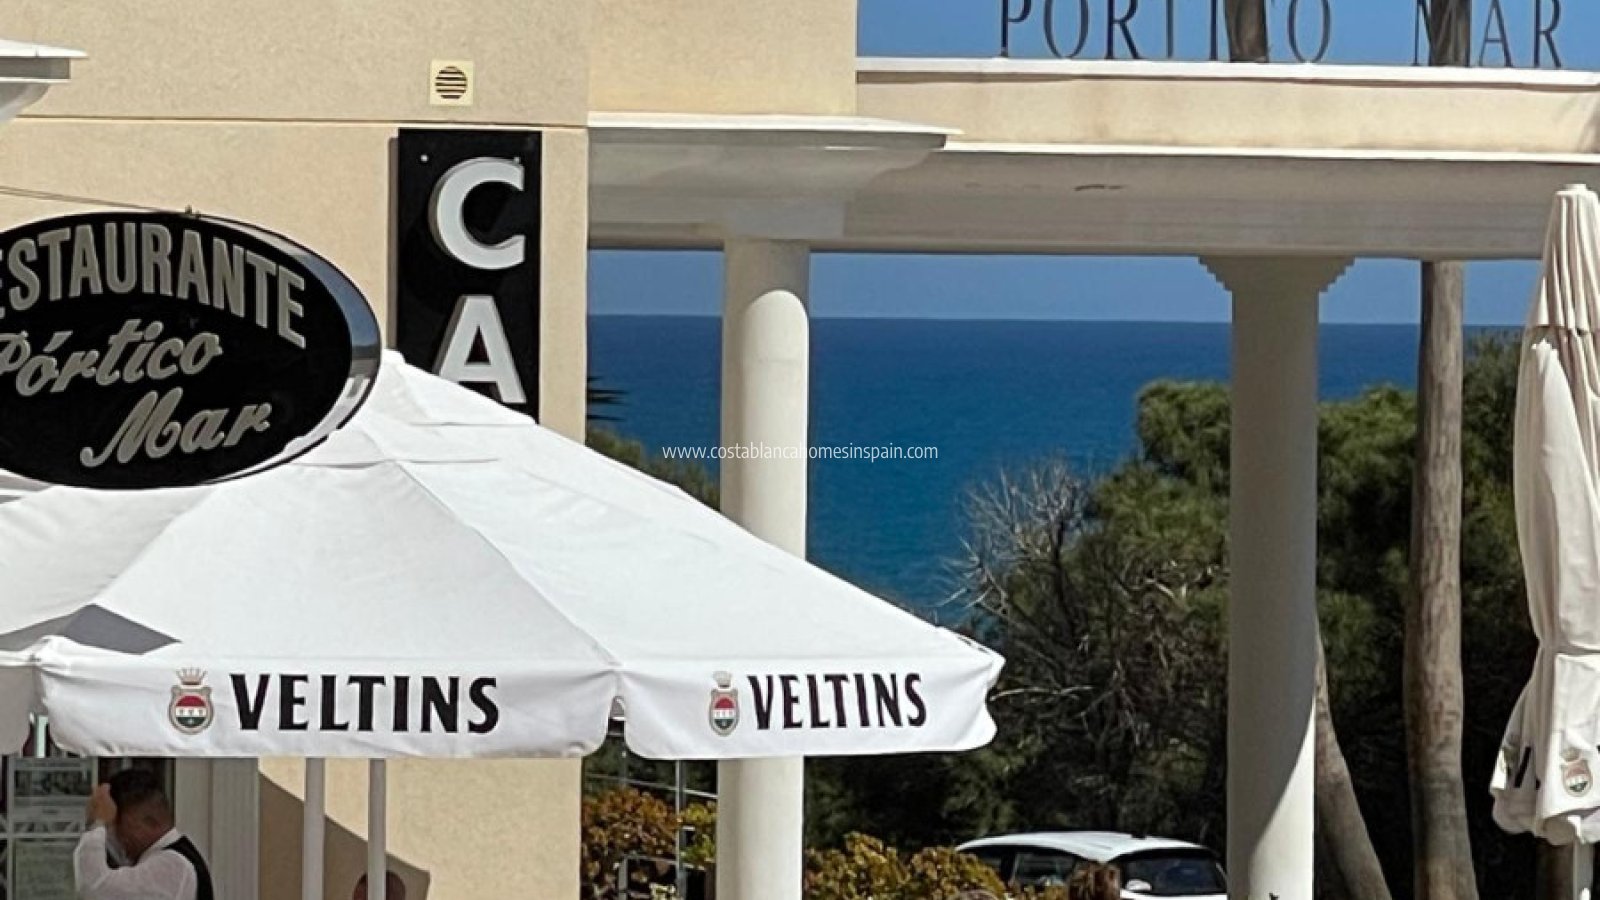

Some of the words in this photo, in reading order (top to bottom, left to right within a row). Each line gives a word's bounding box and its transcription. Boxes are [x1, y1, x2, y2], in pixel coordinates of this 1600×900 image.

[1000, 0, 1331, 63] PORTIO
[0, 222, 307, 349] STAURANTE
[429, 156, 527, 404] CA
[0, 318, 224, 397] Pórtico
[80, 387, 272, 468] Mar
[229, 673, 500, 733] VELTINS
[746, 672, 927, 730] VELTINS
